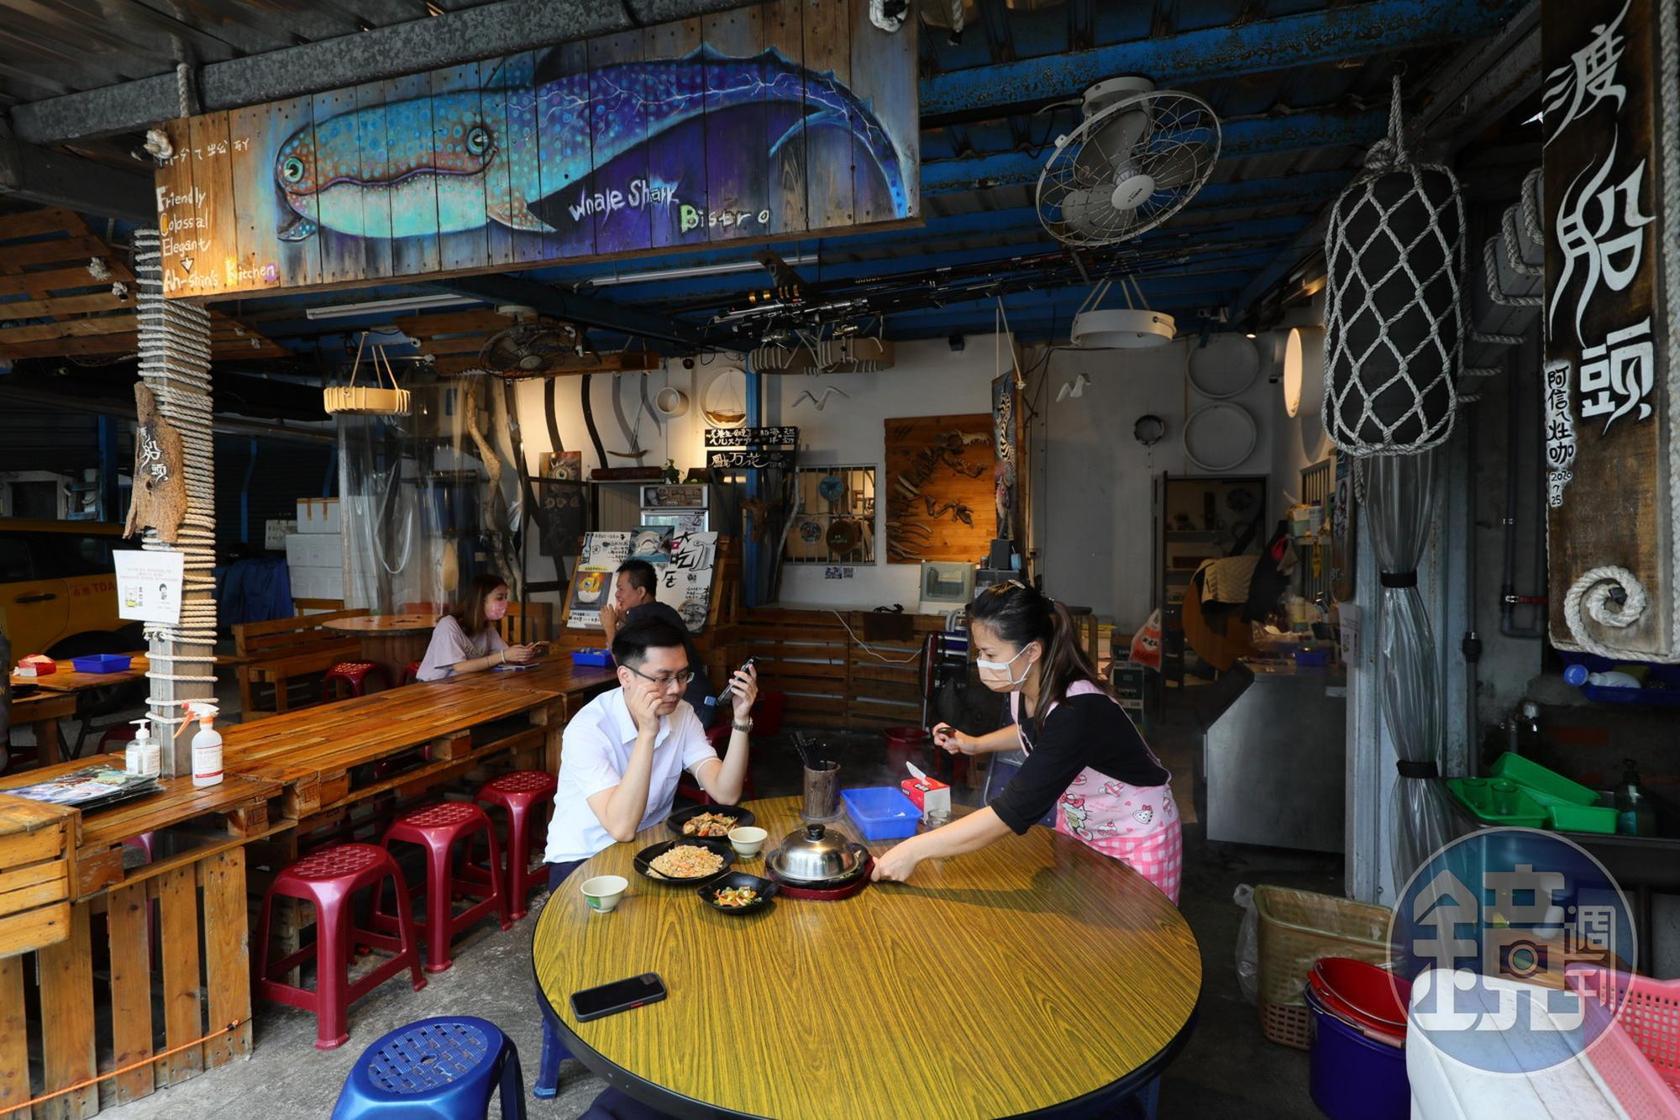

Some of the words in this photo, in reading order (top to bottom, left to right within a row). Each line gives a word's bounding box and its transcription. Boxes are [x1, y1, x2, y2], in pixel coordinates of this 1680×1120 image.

[156, 185, 206, 212] Friendly
[627, 179, 680, 216] Shark
[679, 204, 770, 233] Bistro
[160, 208, 209, 237] Colossal
[162, 239, 212, 257] Elegant
